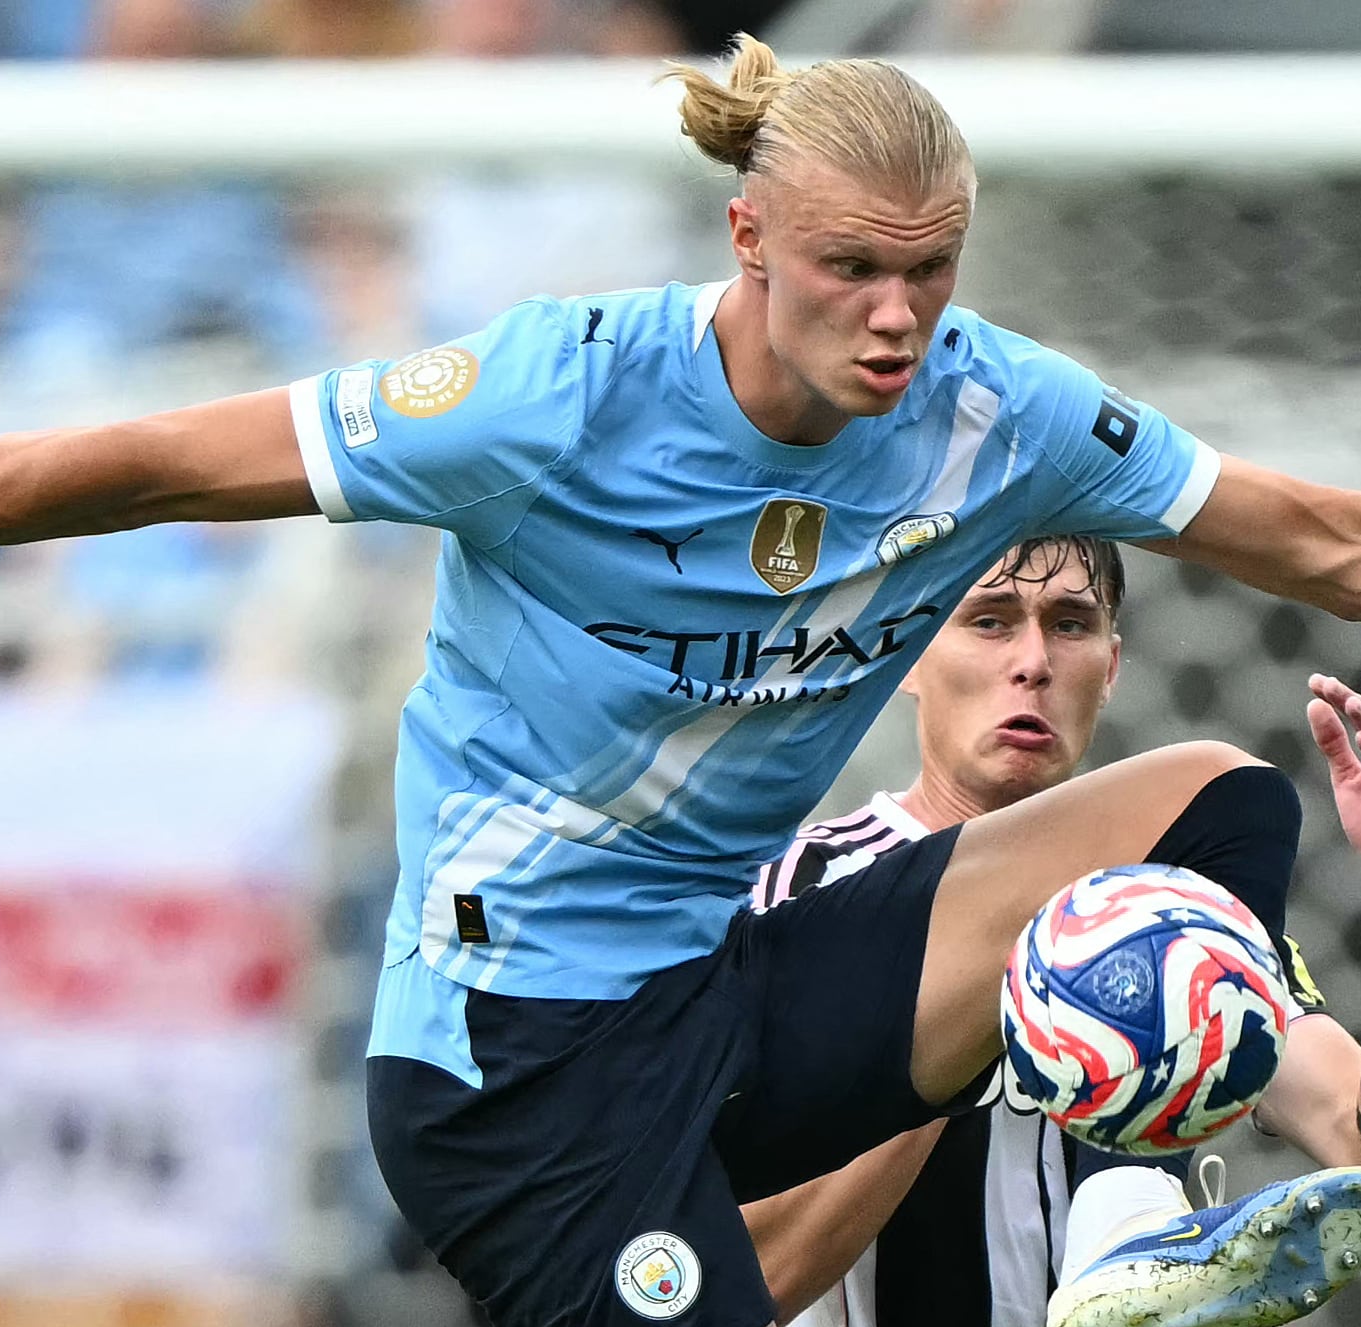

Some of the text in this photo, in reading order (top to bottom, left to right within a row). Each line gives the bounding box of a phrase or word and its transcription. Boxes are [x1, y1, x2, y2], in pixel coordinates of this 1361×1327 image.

[768, 556, 800, 572] FIFA
[621, 1237, 677, 1285] MANCHESTER
[668, 1293, 688, 1312] CITY
